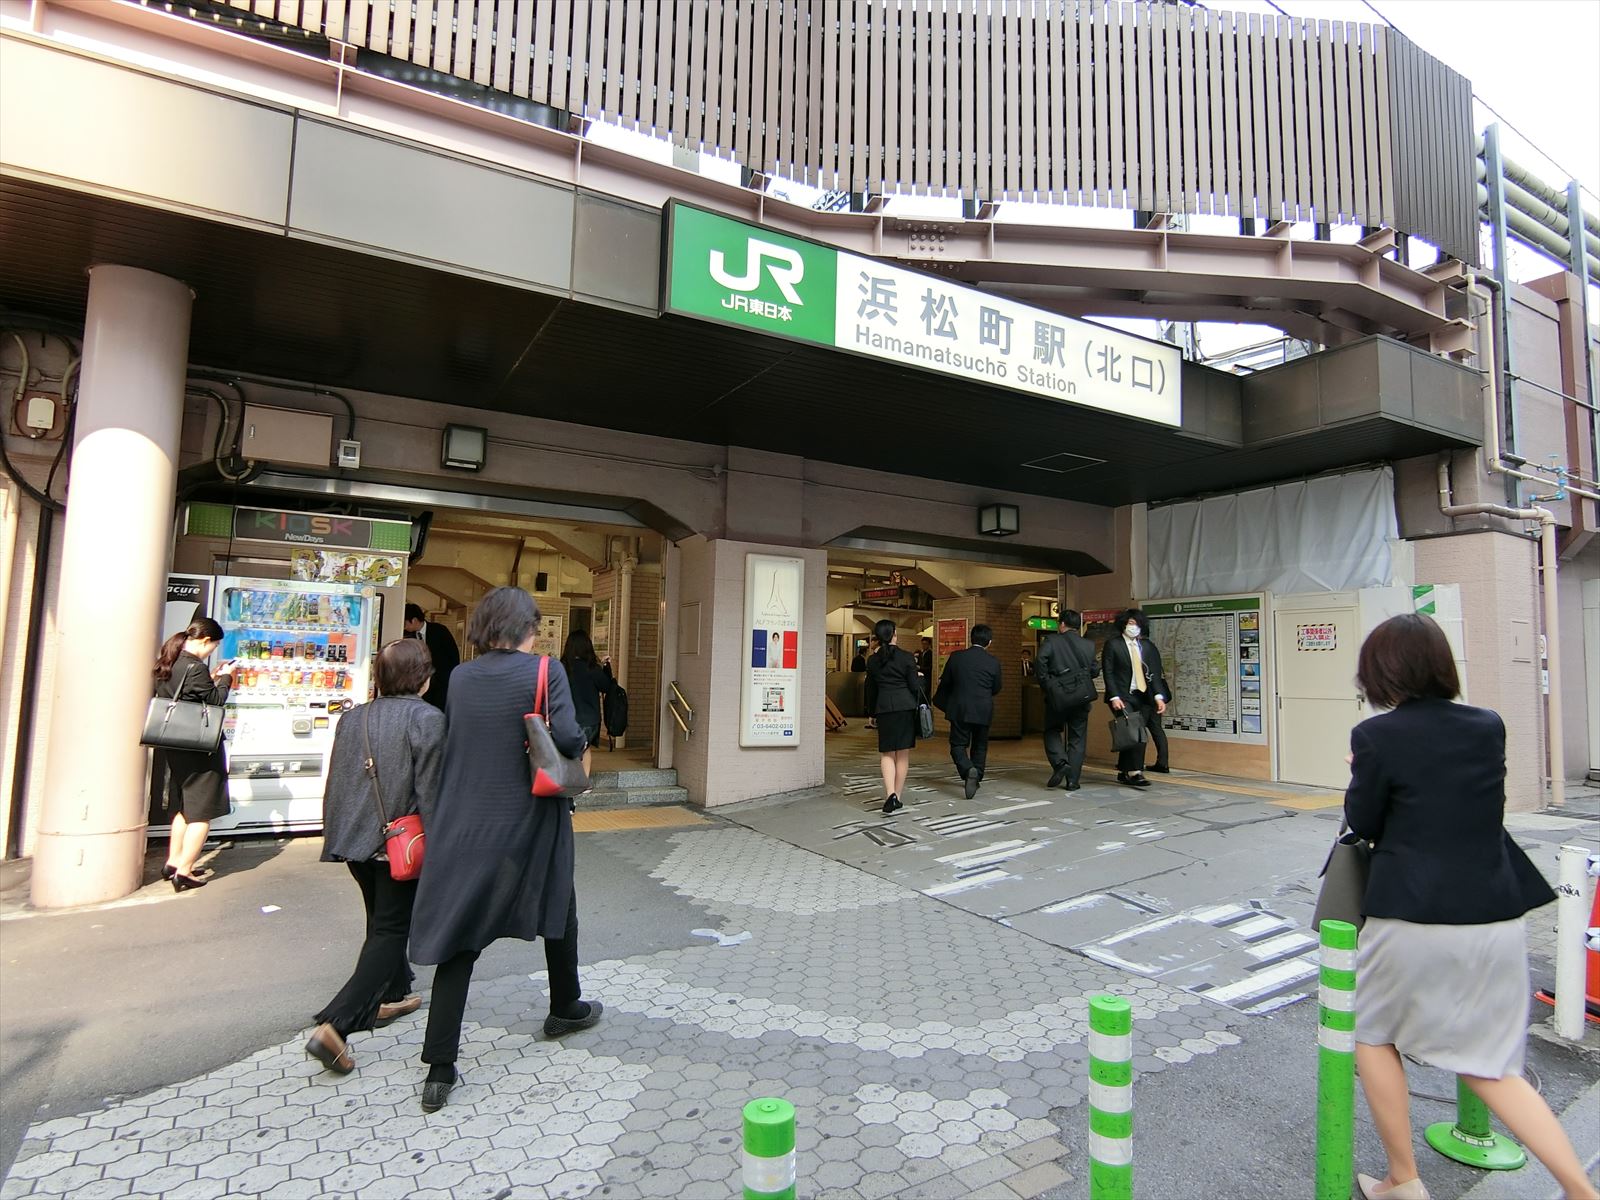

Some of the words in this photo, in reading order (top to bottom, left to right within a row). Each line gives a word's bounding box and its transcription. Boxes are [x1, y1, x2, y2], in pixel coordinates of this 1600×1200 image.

[708, 237, 805, 306] JR
[721, 298, 794, 322] JR東日本
[856, 325, 1008, 379] Hamamatsuchō
[1017, 366, 1078, 395] Station
[255, 511, 353, 535] KIOSK
[284, 532, 325, 544] NewDays
[167, 586, 201, 595] acure
